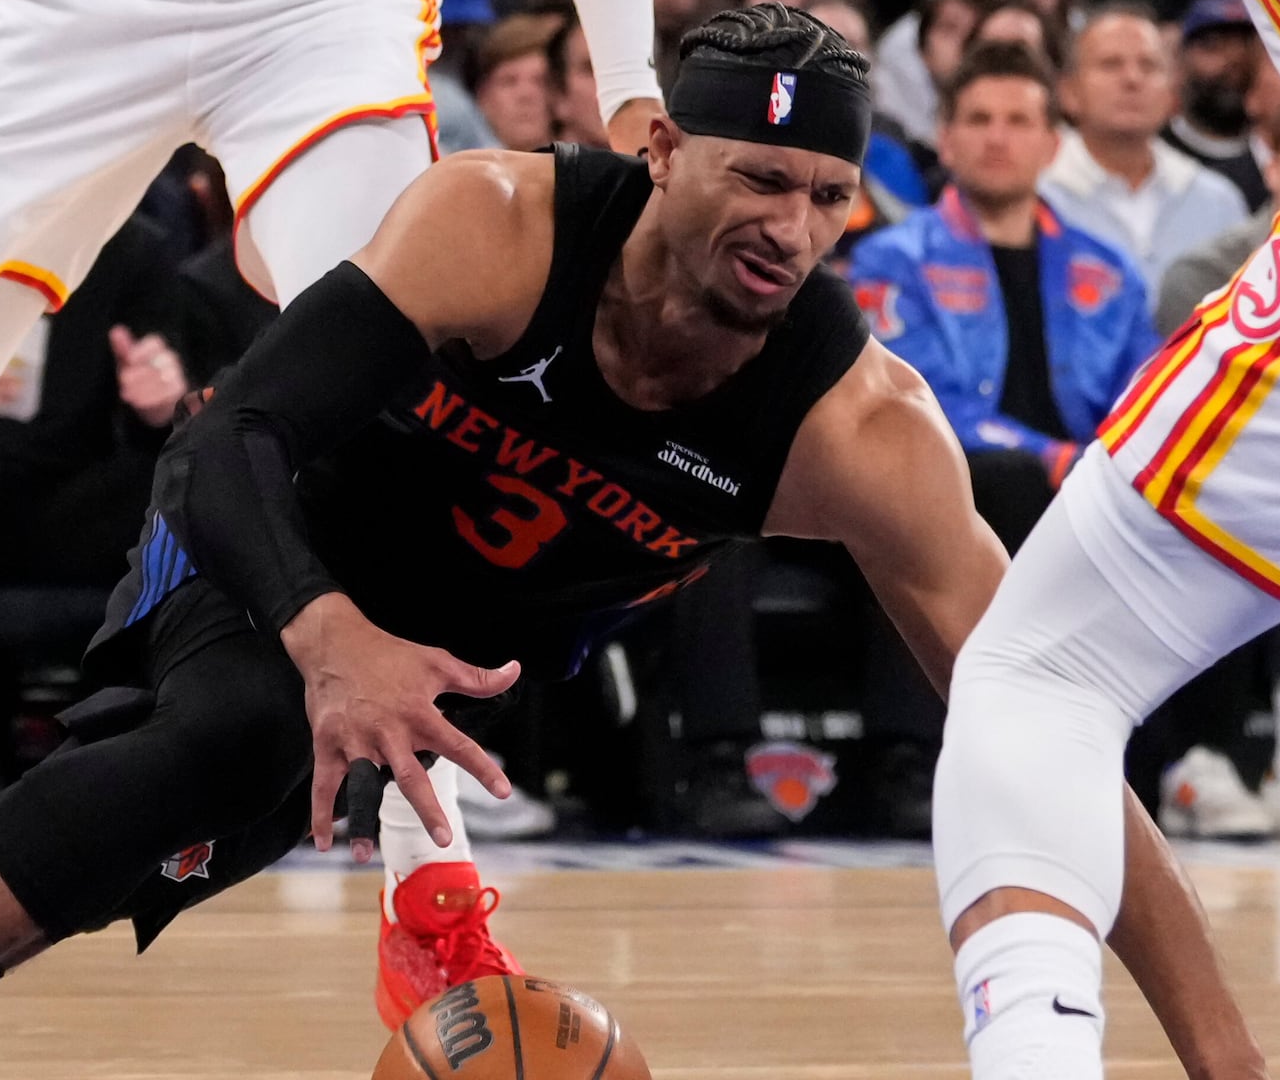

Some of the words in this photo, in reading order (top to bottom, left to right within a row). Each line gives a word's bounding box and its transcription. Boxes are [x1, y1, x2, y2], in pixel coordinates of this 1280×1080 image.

[414, 381, 560, 474] NEW
[555, 457, 700, 559] YORK
[657, 449, 691, 473] abu
[691, 464, 742, 497] dhabi
[451, 473, 568, 569] 3
